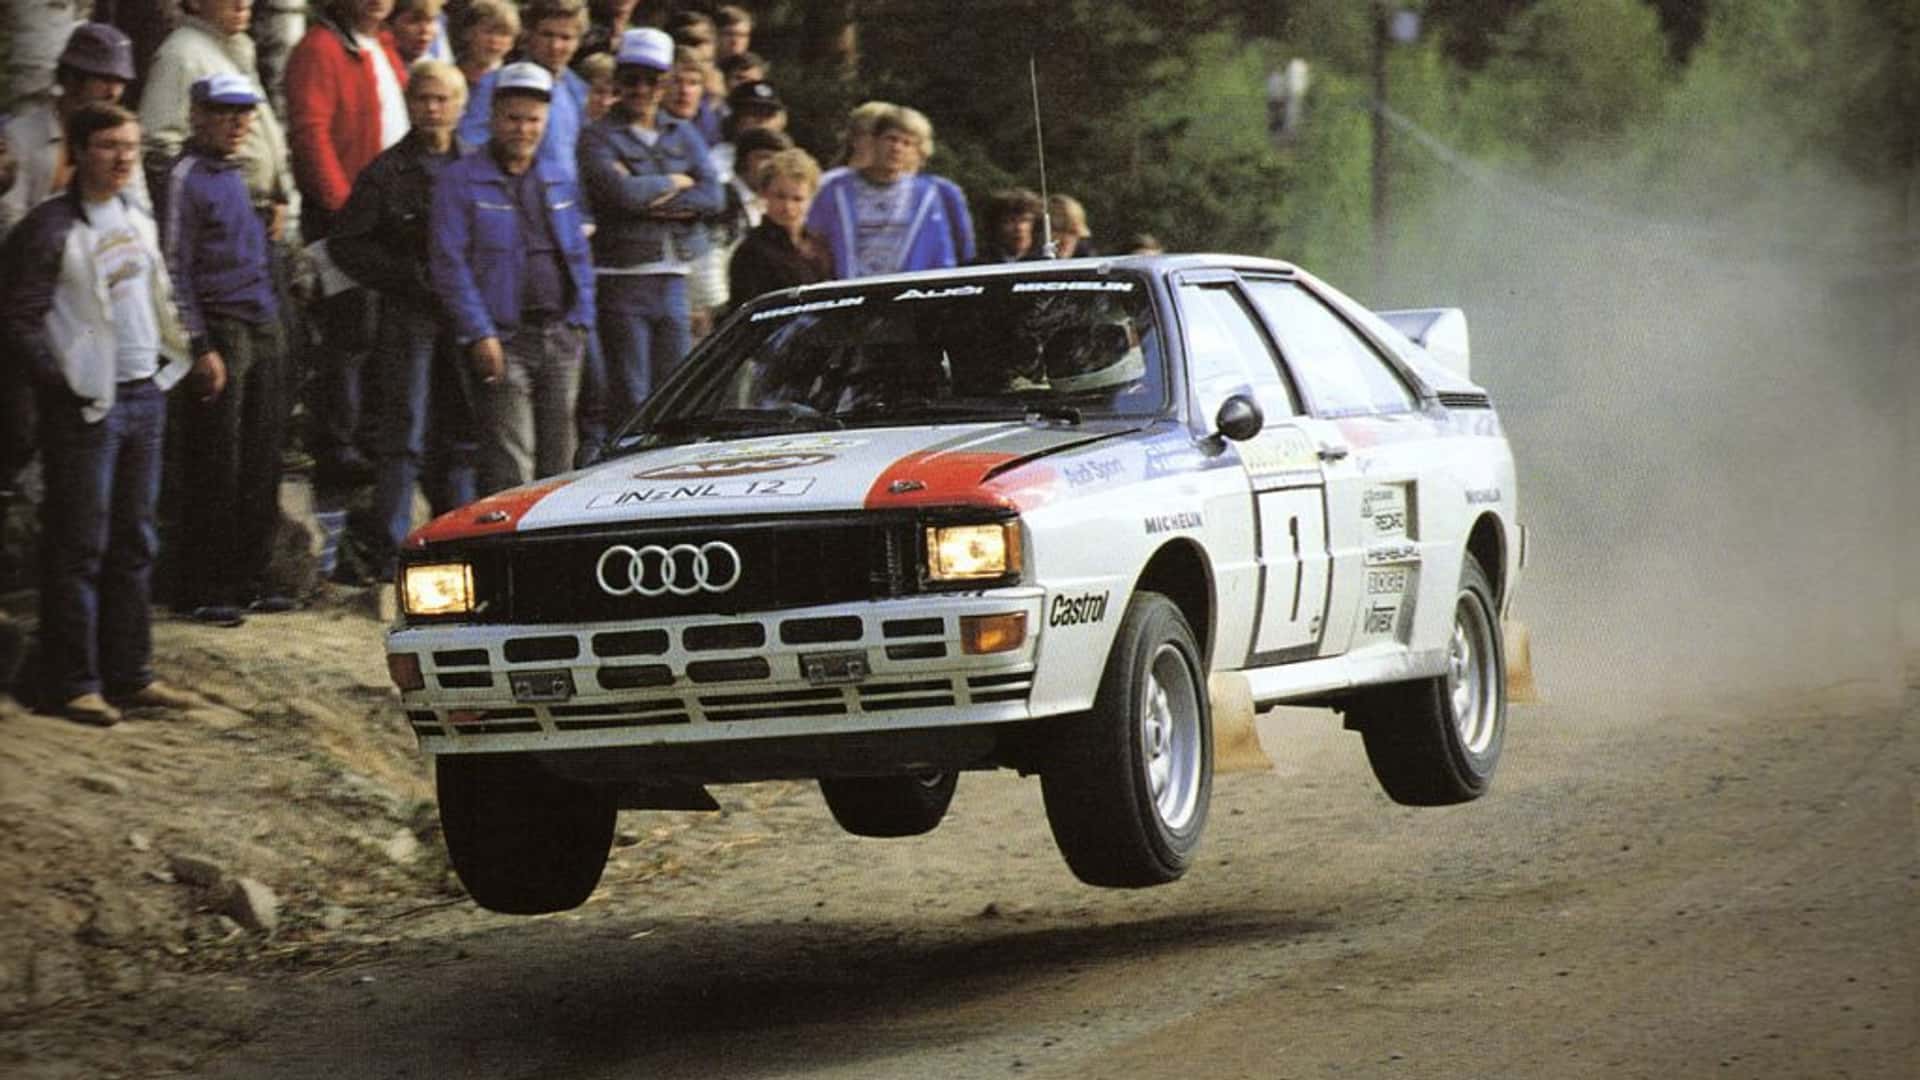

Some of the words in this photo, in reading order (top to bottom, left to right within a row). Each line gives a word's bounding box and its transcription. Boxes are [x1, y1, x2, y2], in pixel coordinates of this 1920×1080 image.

[1012, 281, 1135, 293] MICHELIN
[750, 297, 866, 322] MICHELIN
[745, 479, 786, 495] 12
[1144, 511, 1203, 534] MICHELIN
[1289, 515, 1303, 623] 1
[1049, 589, 1110, 627] Castrol
